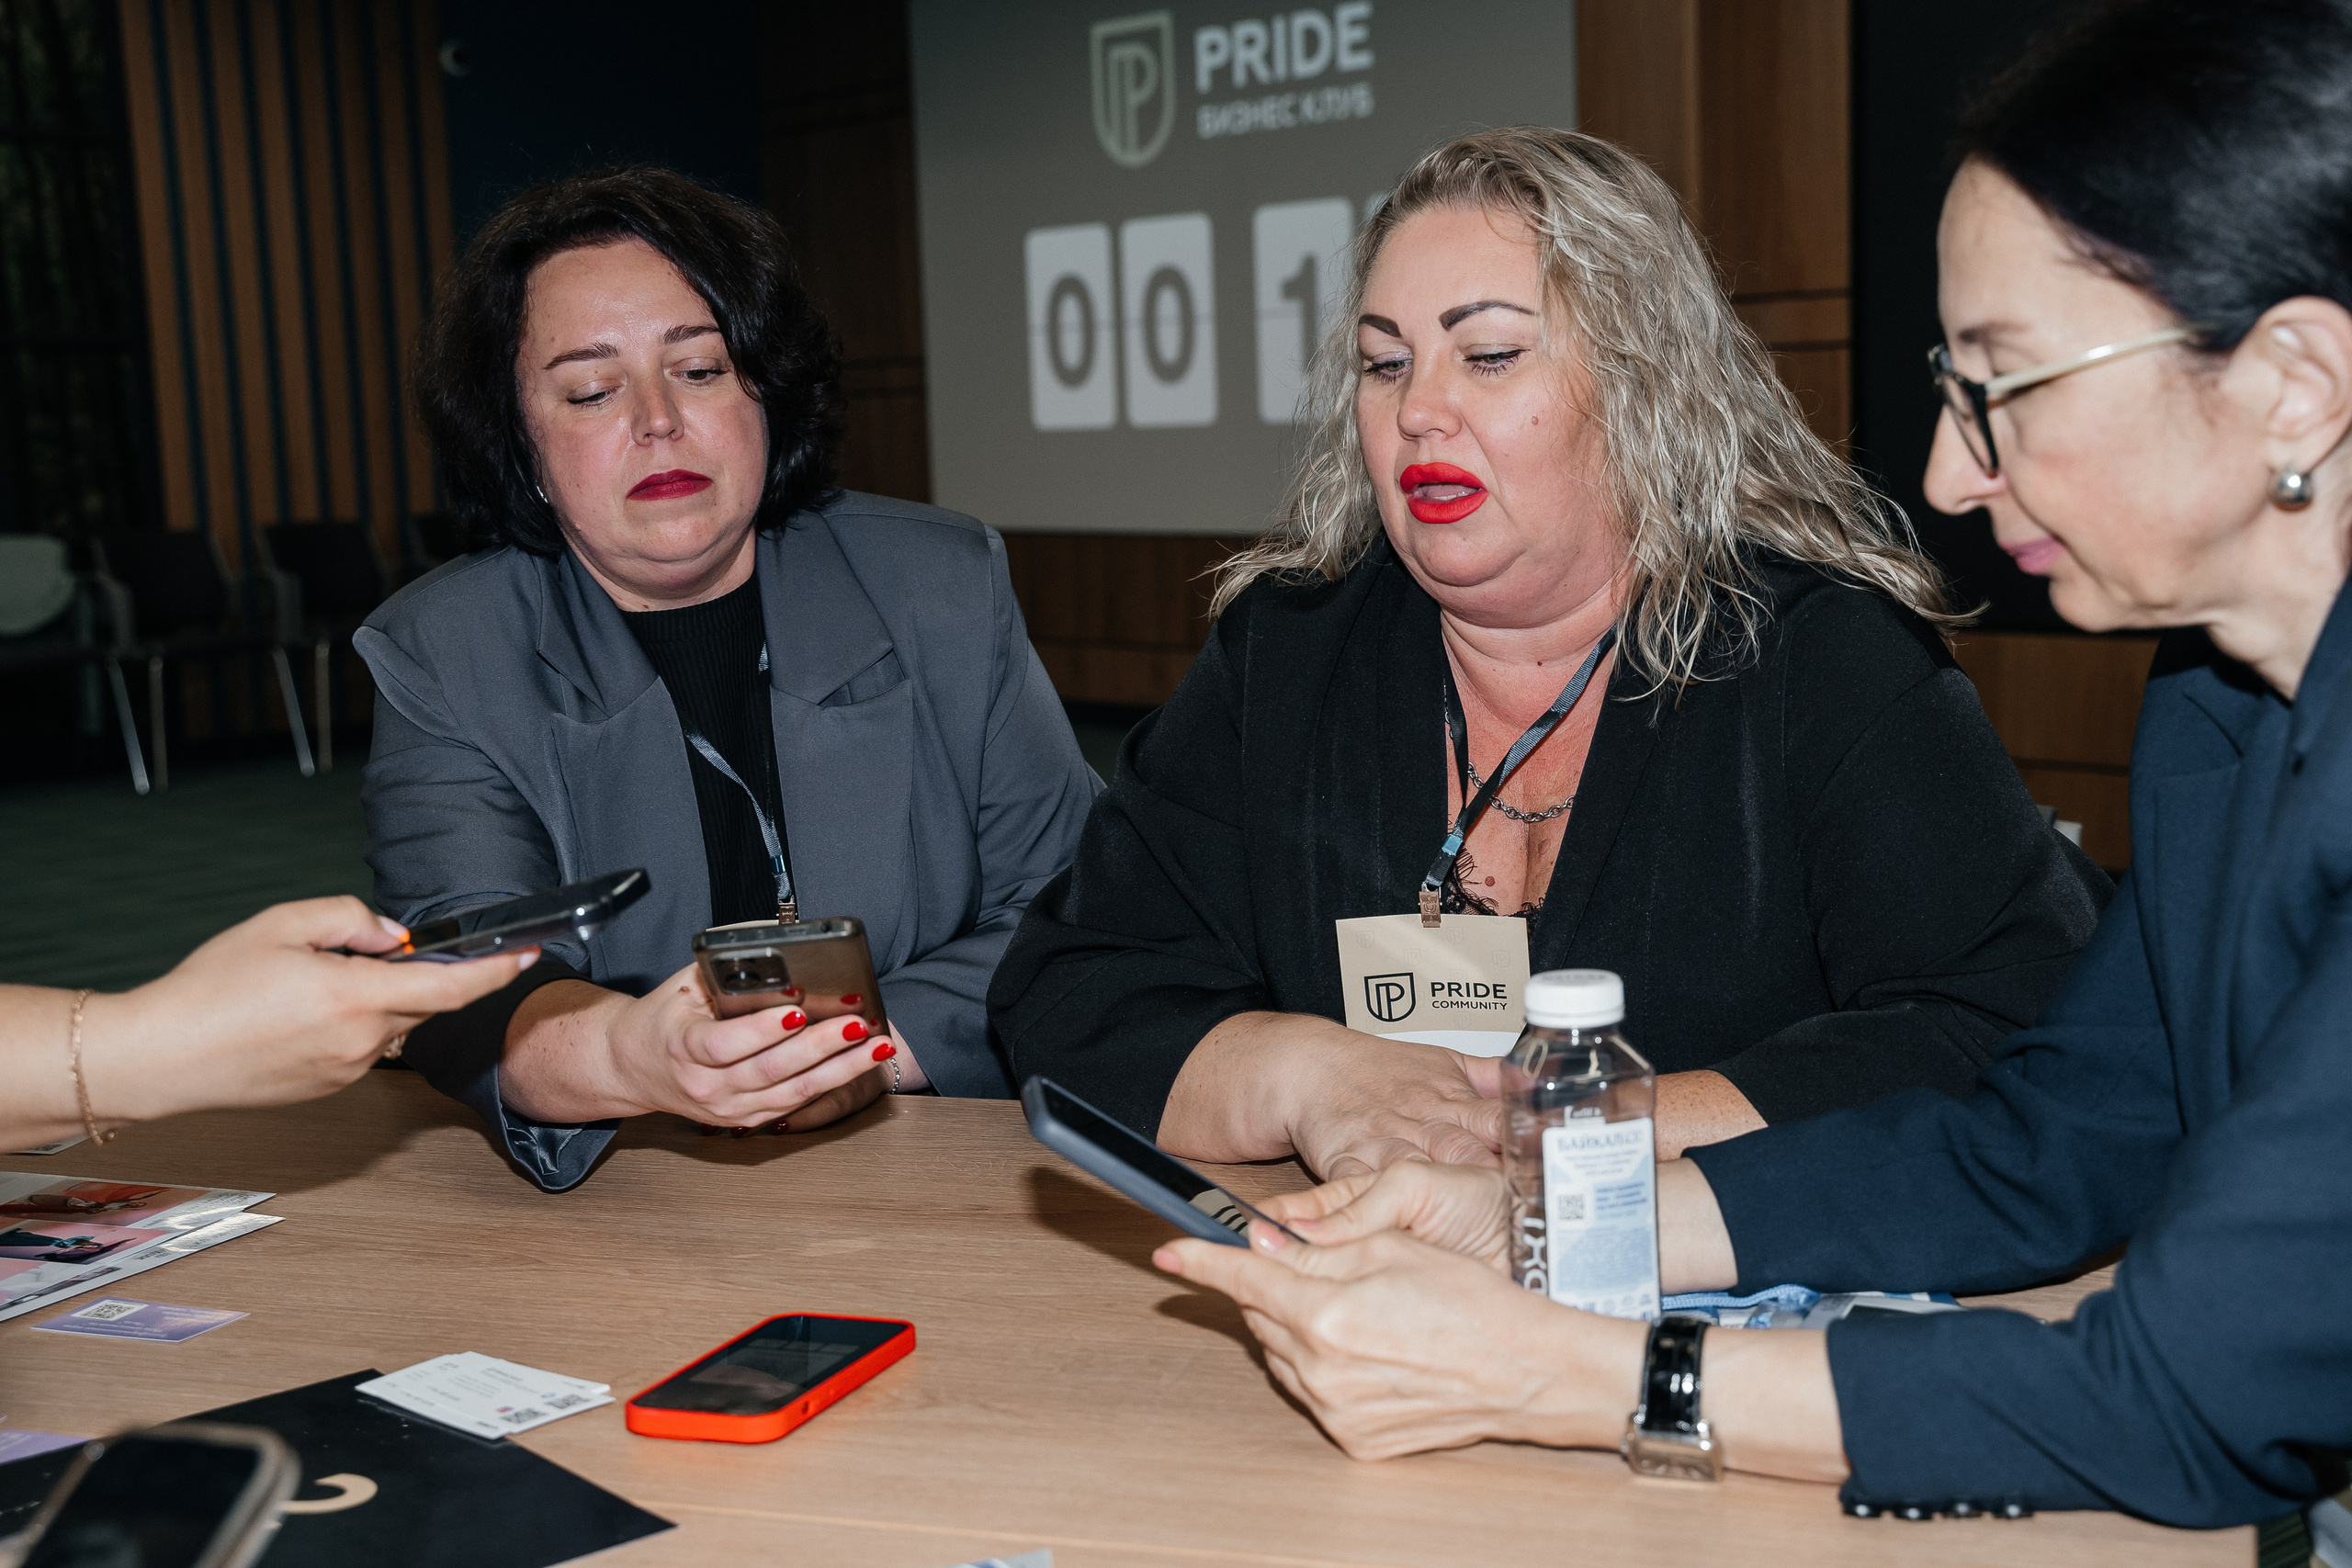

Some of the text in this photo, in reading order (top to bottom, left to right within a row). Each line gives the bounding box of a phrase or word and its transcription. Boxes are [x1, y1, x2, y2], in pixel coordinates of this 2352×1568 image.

[1194, 1, 1375, 95] PRIDE
[1430, 981, 1508, 999] PRIDE
[1431, 1000, 1509, 1011] COMMUNITY
